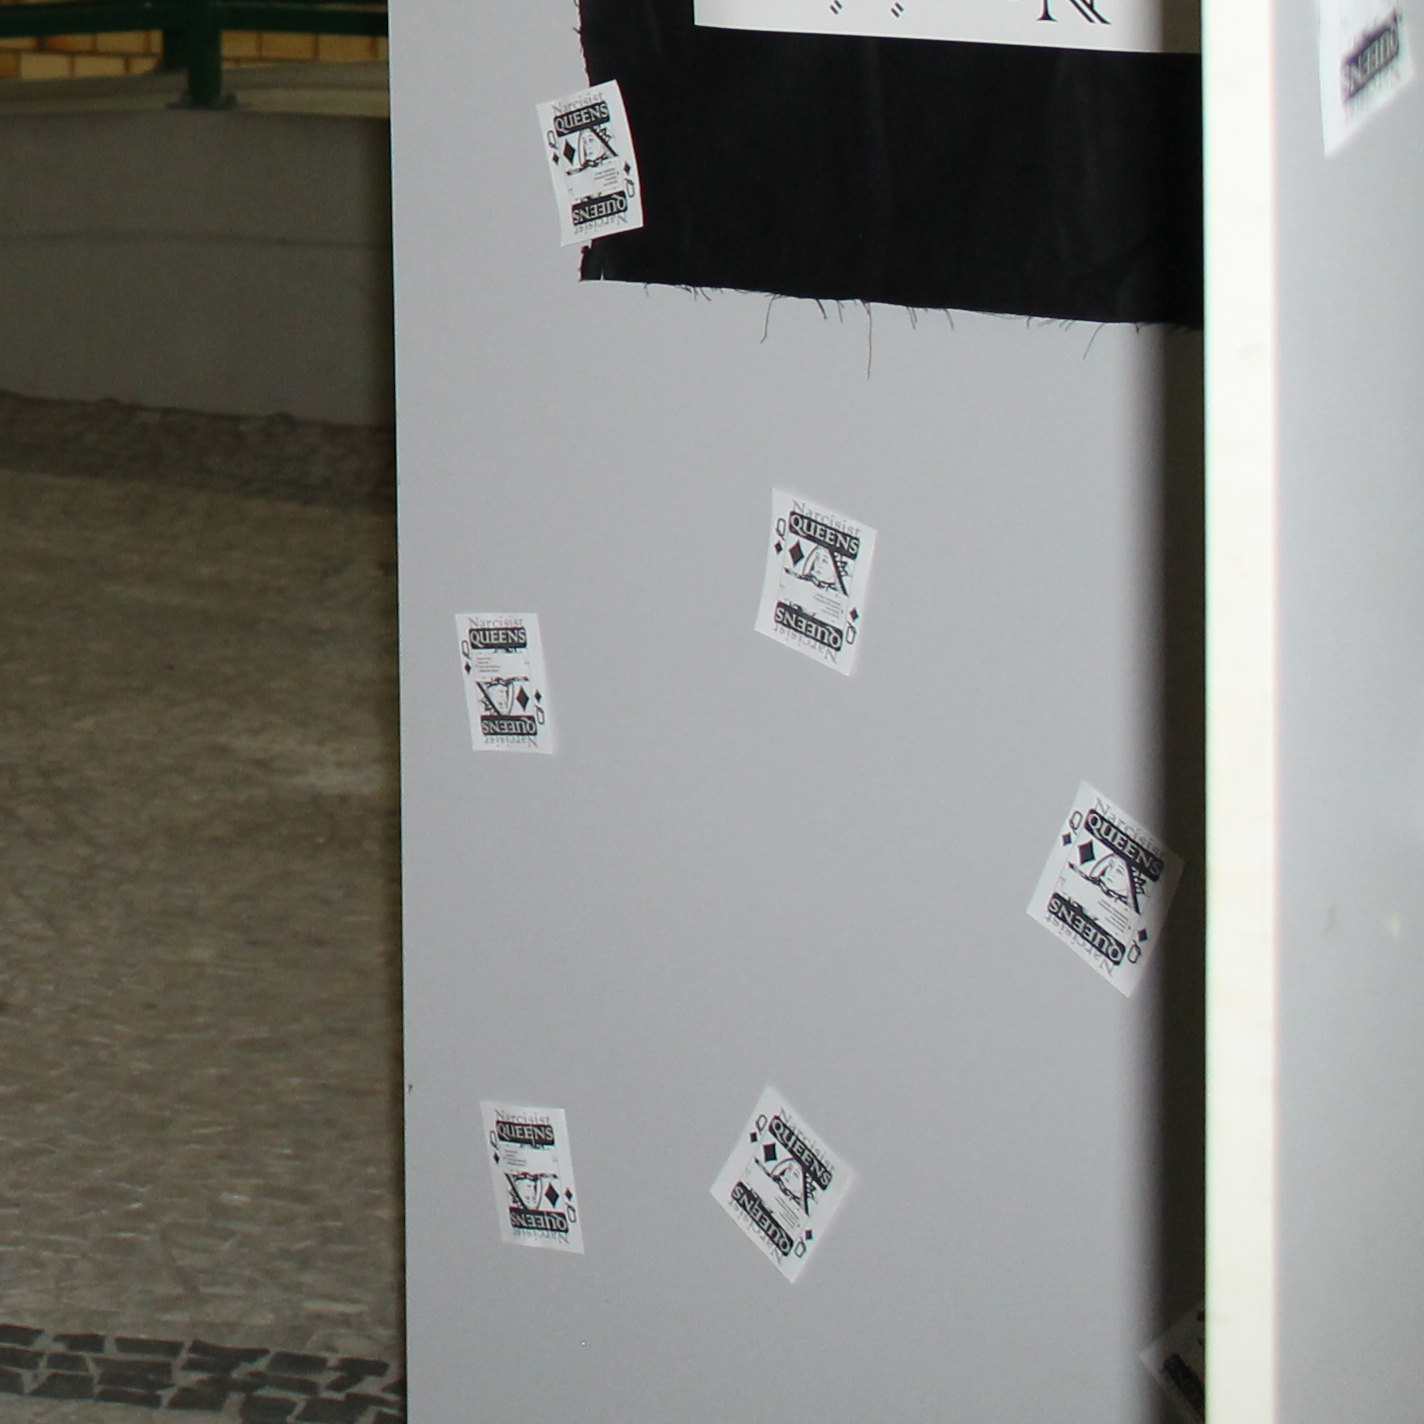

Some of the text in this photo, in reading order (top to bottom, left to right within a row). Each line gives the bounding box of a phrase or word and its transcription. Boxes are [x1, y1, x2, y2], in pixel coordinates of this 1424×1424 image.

[555, 104, 609, 134] QUEENS
[573, 193, 627, 225] QUEENS
[790, 514, 860, 555] QUEENS
[470, 630, 527, 648] QUEENS
[775, 606, 842, 649] QUEENS
[482, 716, 537, 735] QUEENS
[1087, 812, 1165, 877] QUEENS
[1048, 896, 1125, 962] QUEENS
[497, 1123, 554, 1142] QUEENS
[771, 1119, 832, 1187] QUEENS
[510, 1211, 568, 1231] QUEENS
[731, 1185, 792, 1253] QUEENS
